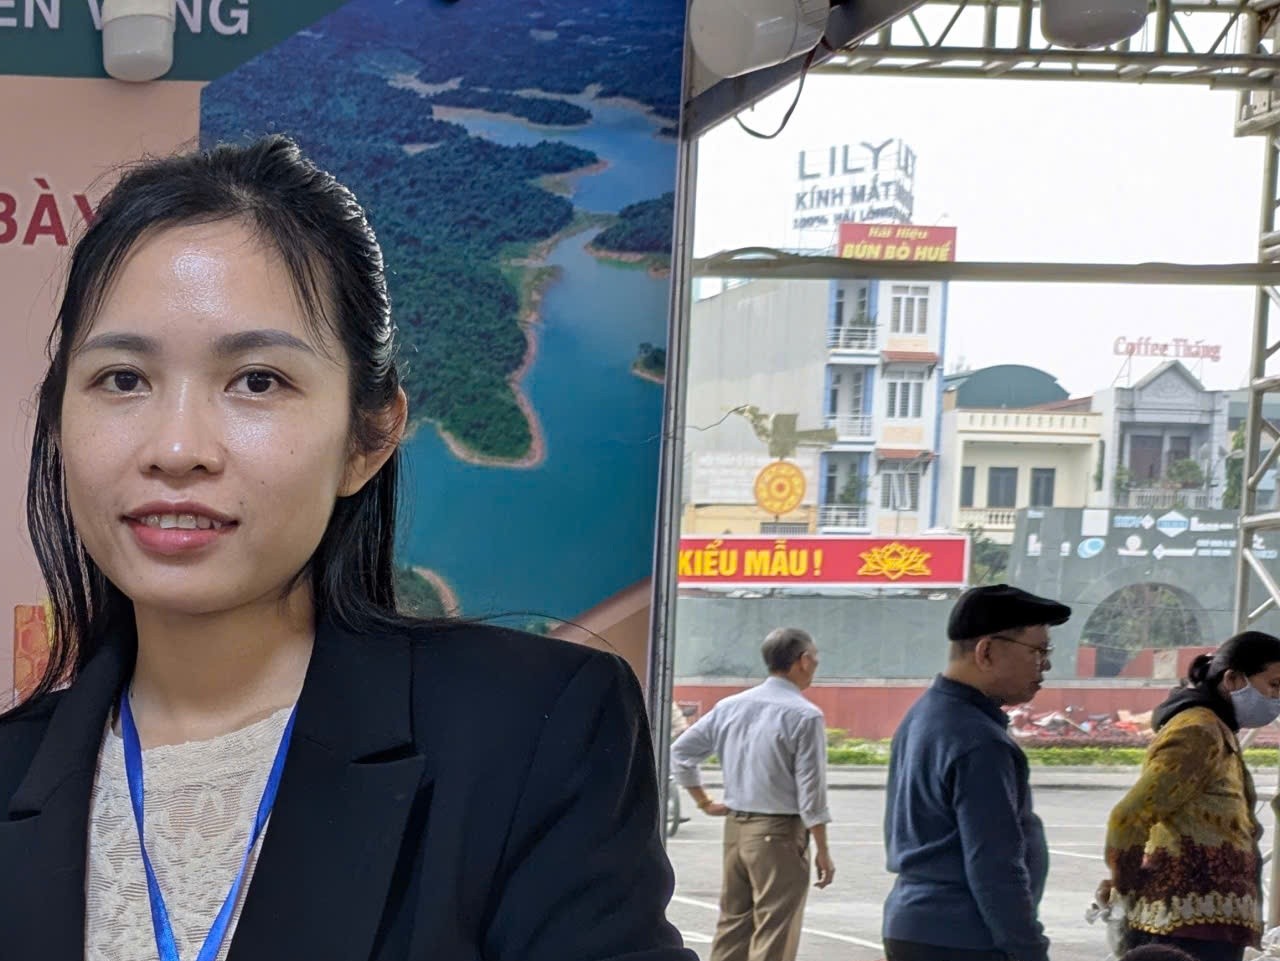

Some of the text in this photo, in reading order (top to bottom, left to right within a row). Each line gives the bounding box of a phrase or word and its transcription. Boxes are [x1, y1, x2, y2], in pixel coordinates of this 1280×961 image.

[798, 138, 894, 180] LILY
[795, 184, 844, 210] KÍNH
[843, 240, 951, 261] BÚN BÒ HUẾ
[1113, 336, 1169, 357] Coffee
[678, 539, 737, 577] KIỂU
